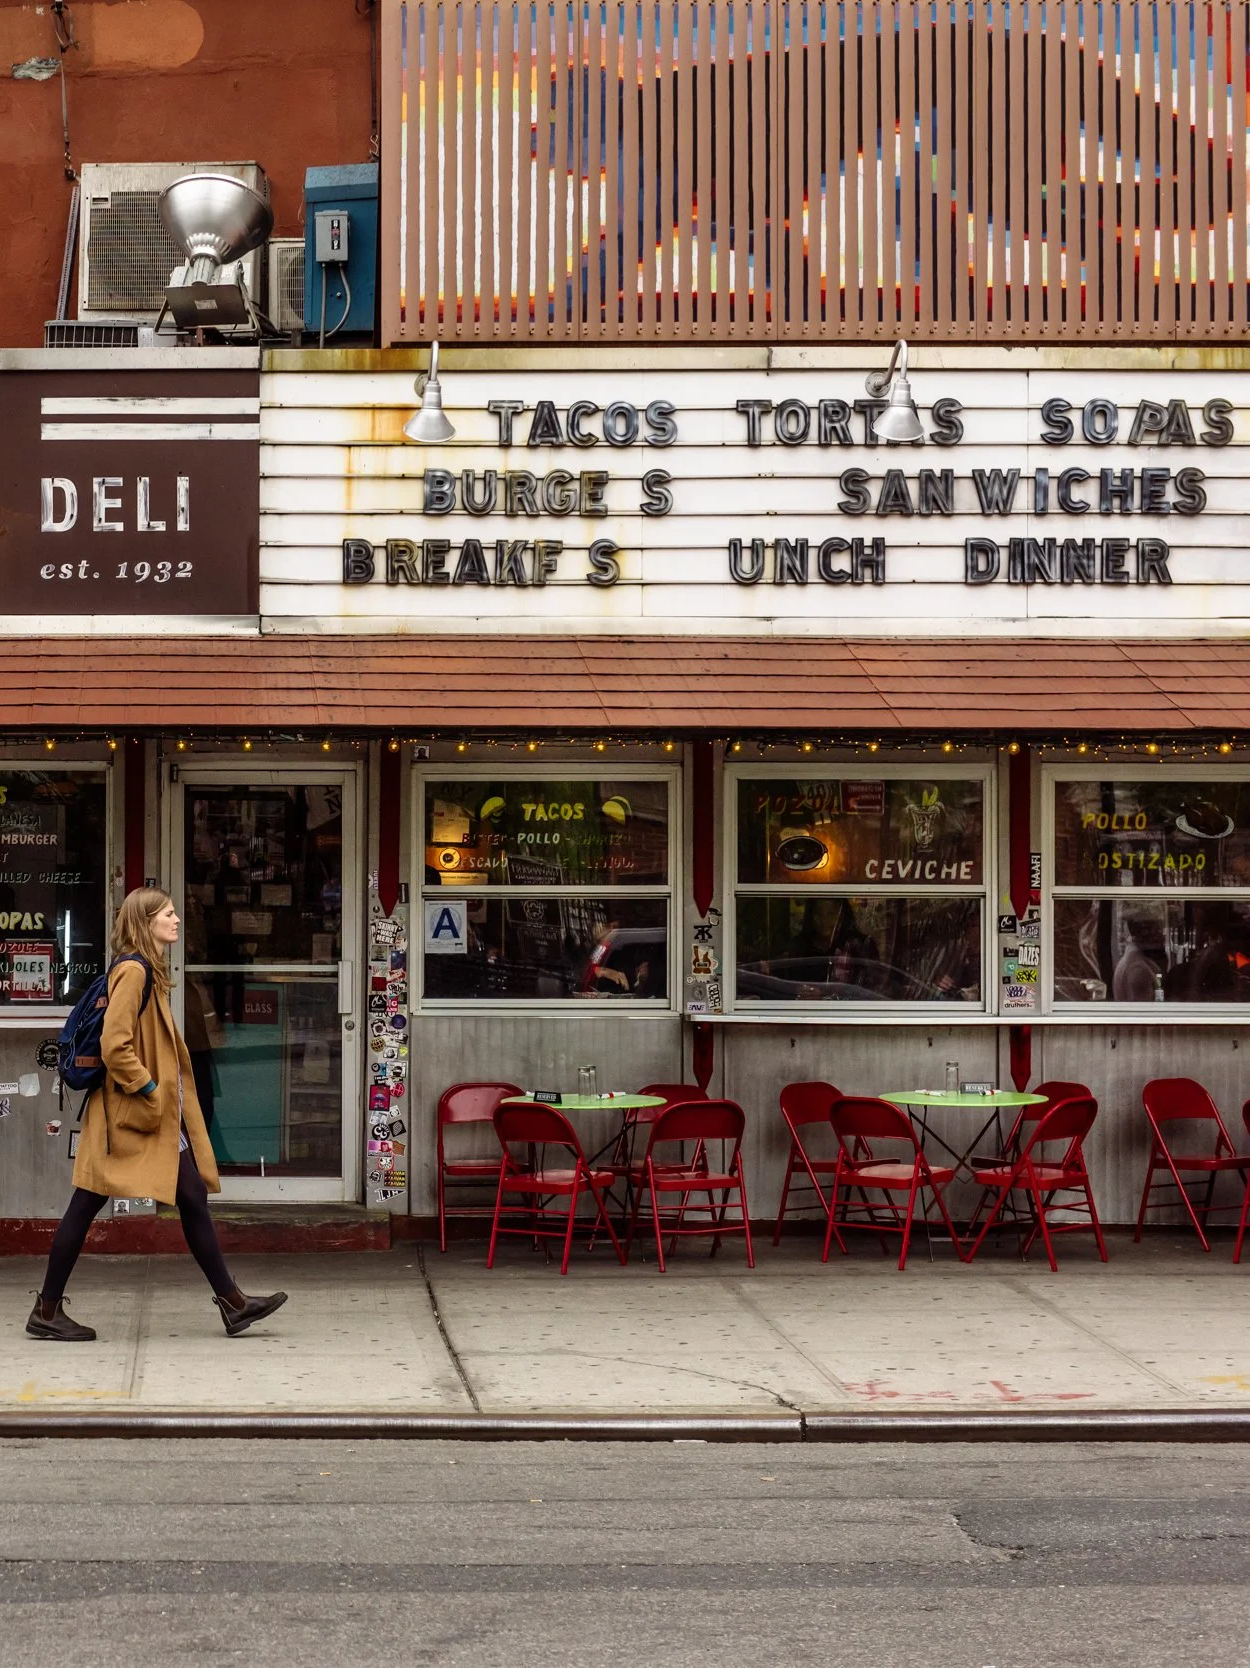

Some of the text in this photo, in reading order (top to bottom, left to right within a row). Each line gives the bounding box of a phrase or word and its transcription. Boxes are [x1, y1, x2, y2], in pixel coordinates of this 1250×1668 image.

[487, 398, 678, 447] TACOS
[736, 398, 964, 446] TORTS
[1040, 397, 1235, 447] SOPAS
[41, 476, 190, 532] DELI
[40, 560, 193, 583] est. 1932
[728, 537, 886, 585] UNCH
[966, 538, 1174, 585] DINNER
[522, 803, 585, 821] TACOS
[1082, 812, 1147, 830] POLLO
[865, 859, 973, 880] CEVICHE
[1097, 852, 1206, 870] OSTIZADO
[432, 907, 460, 939] A
[1018, 946, 1040, 966] DAZES
[244, 1003, 272, 1014] GLASS
